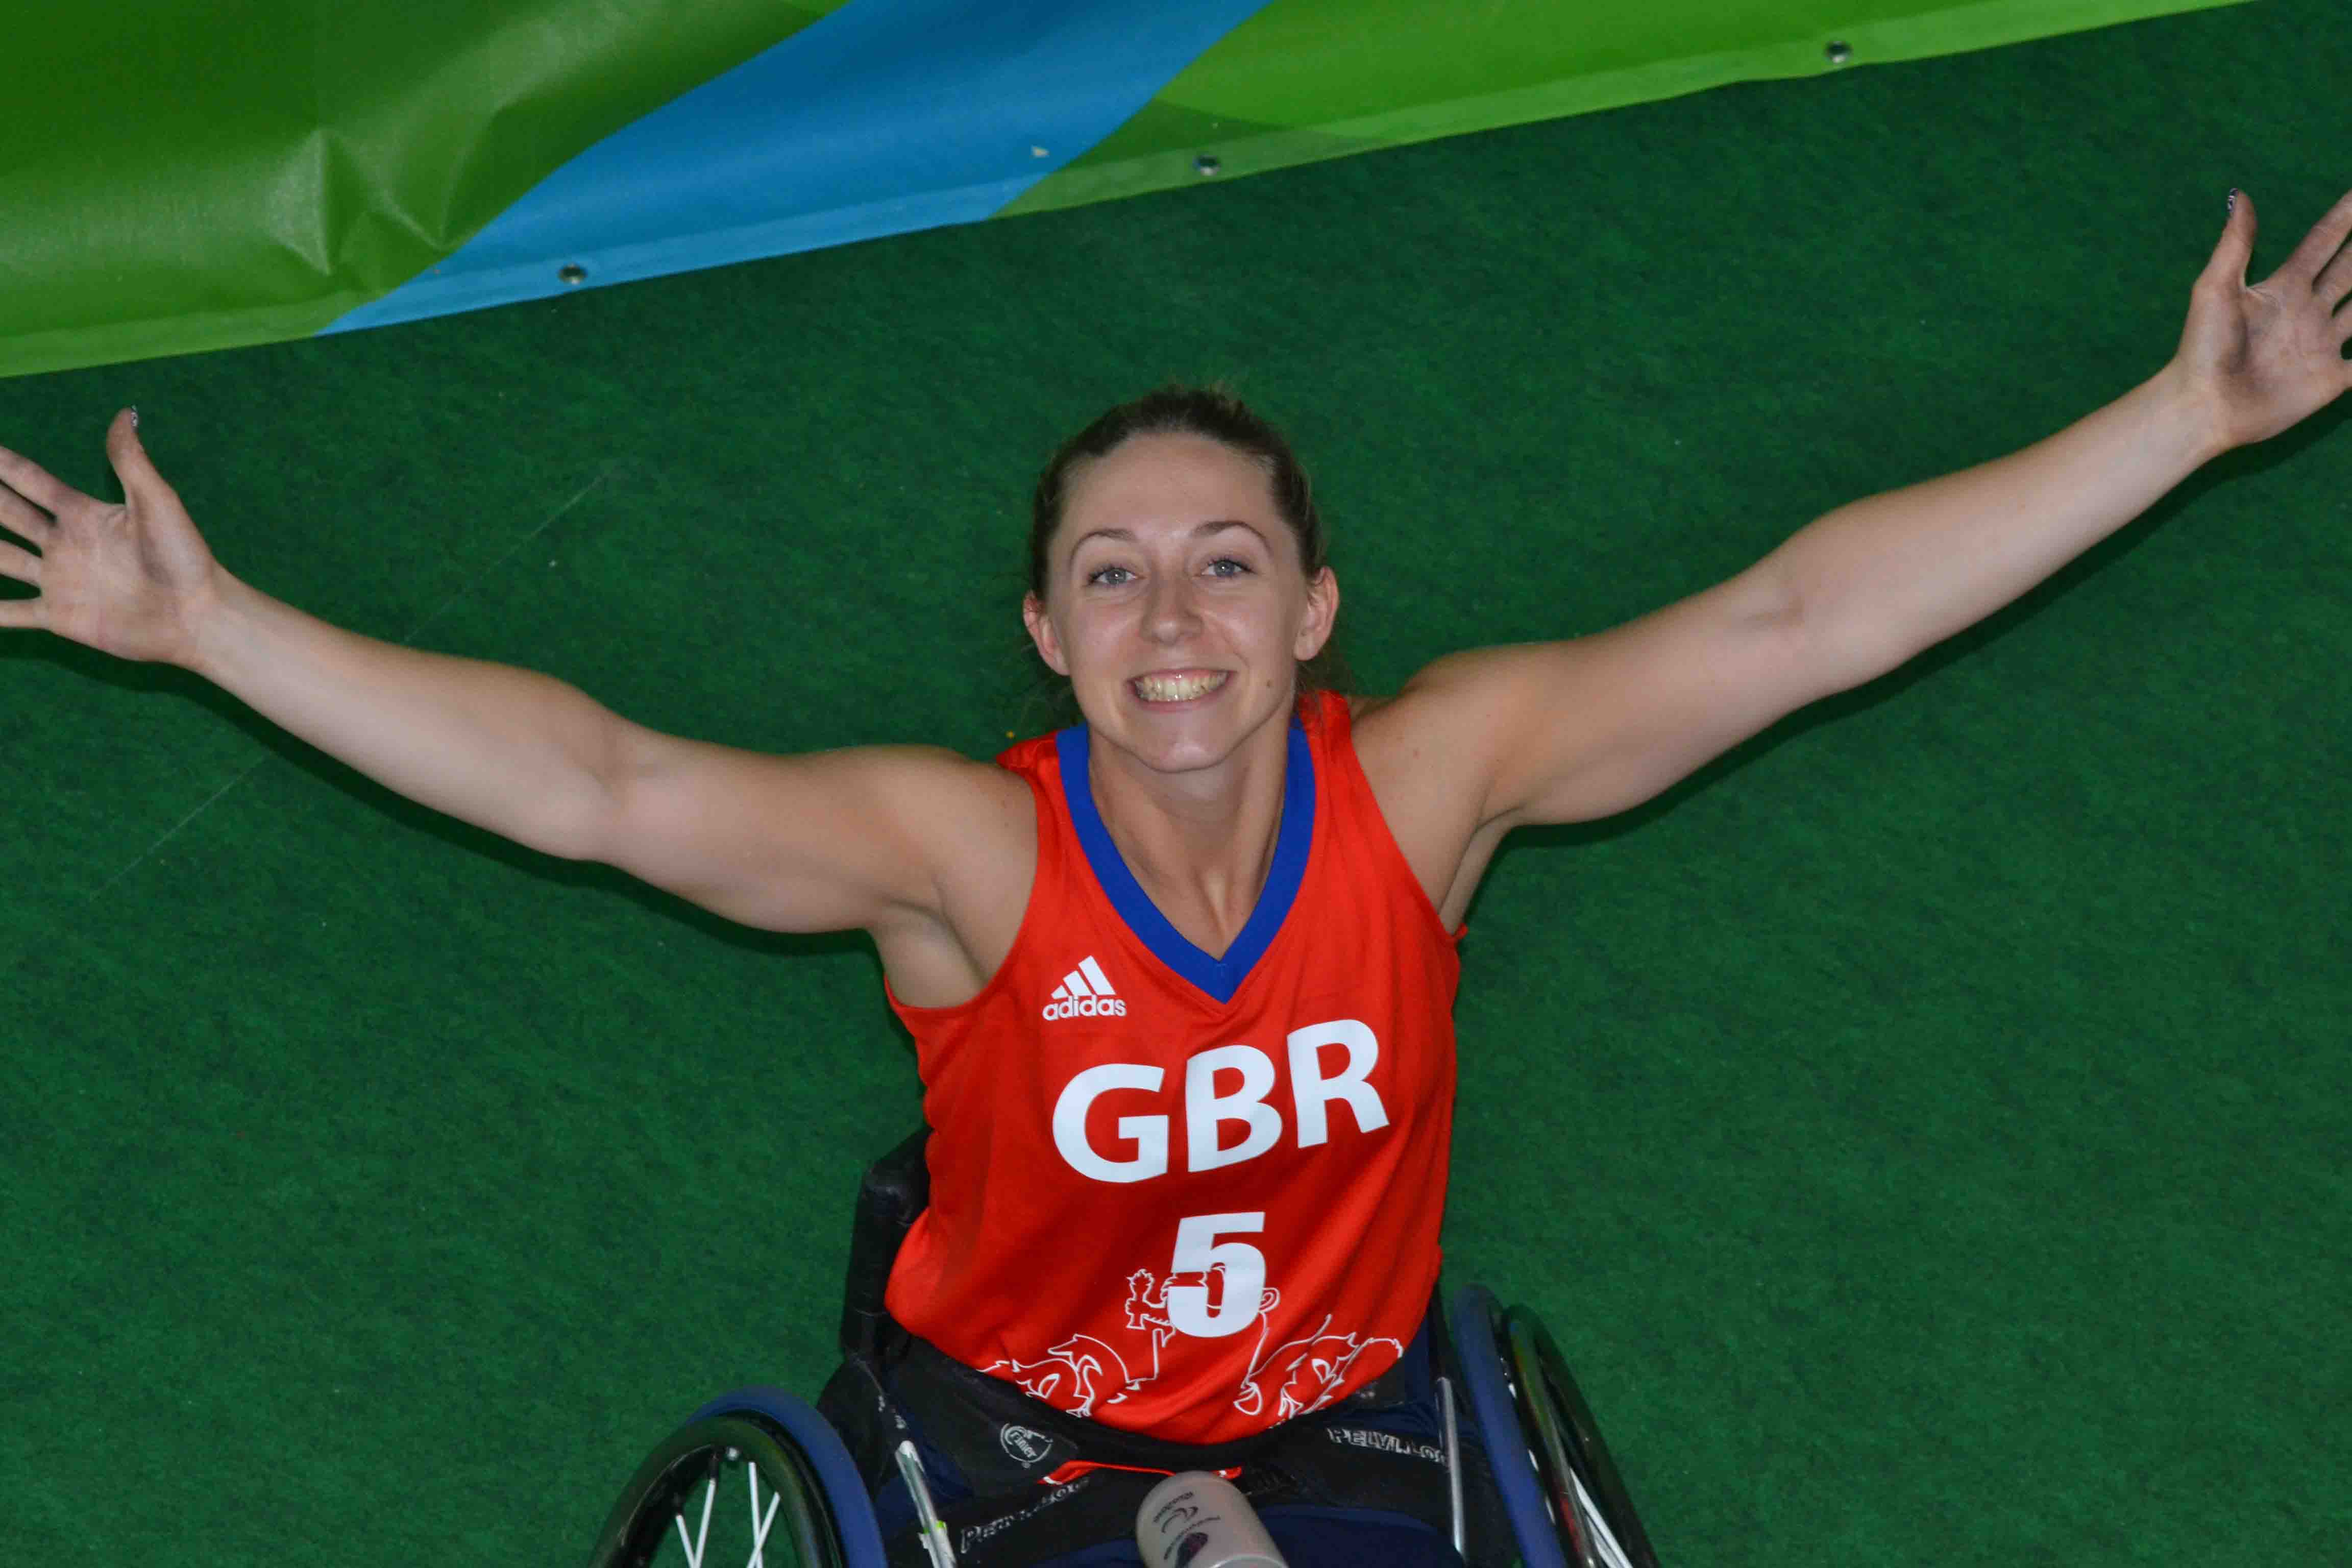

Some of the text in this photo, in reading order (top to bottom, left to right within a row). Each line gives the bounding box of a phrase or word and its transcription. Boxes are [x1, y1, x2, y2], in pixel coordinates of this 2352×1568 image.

[1043, 995, 1126, 1020] adidas
[1052, 1019, 1389, 1183] GBR
[1166, 1212, 1266, 1338] 5
